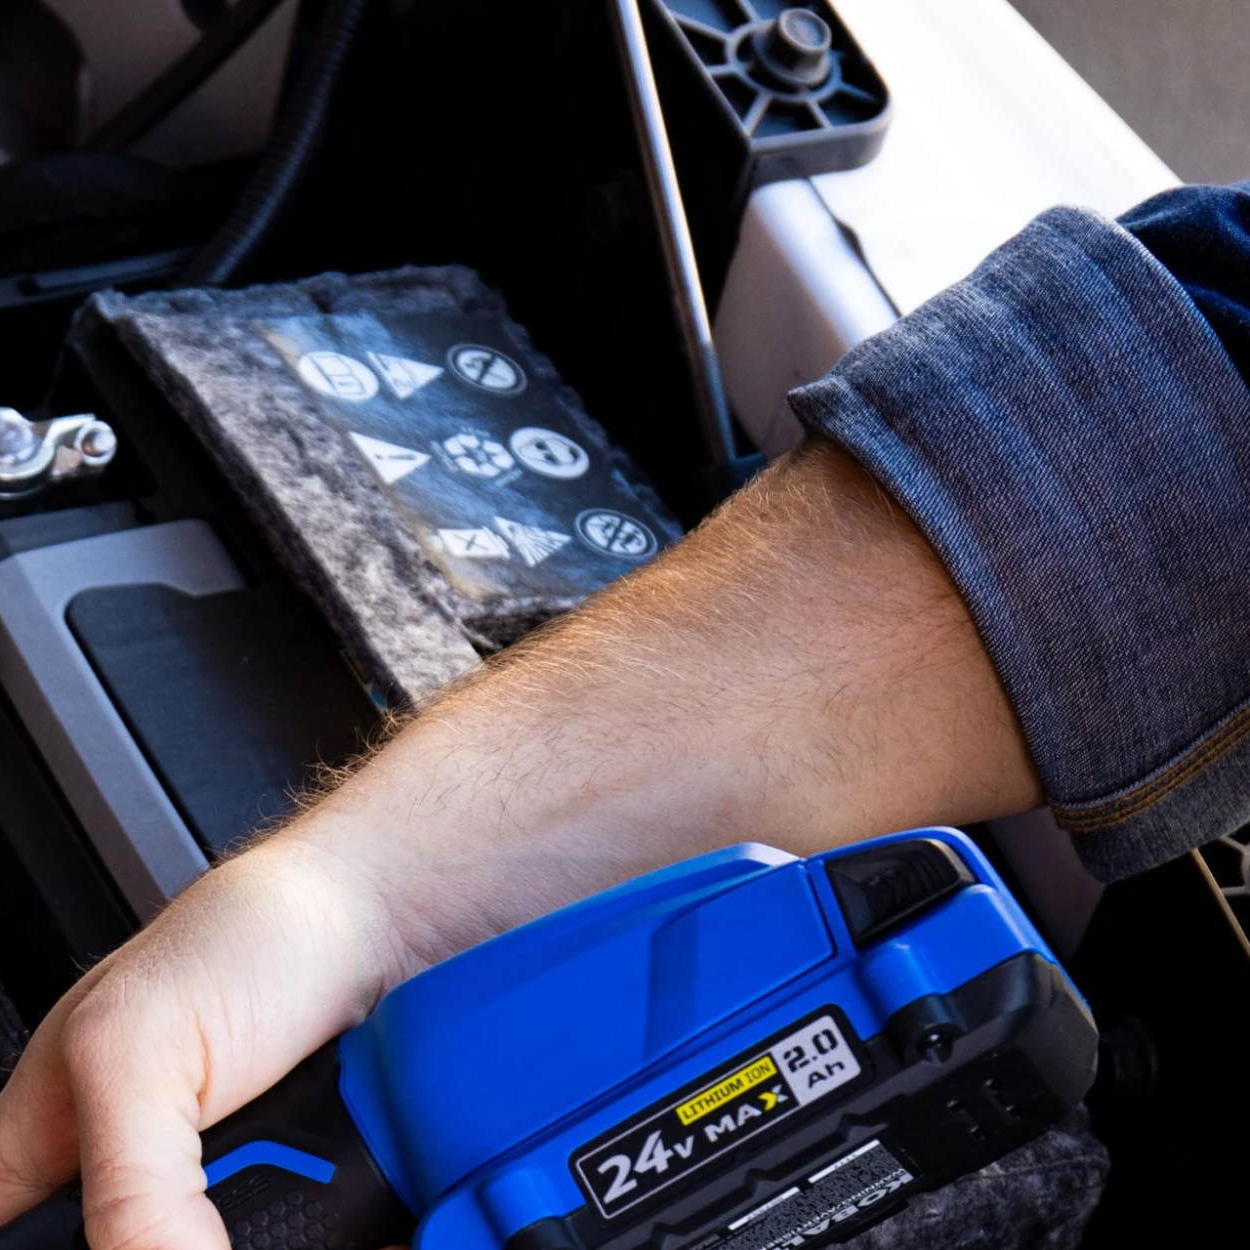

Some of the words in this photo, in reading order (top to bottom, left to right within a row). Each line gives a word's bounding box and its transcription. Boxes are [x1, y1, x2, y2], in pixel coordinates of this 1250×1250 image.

[784, 1028, 839, 1073] 2.0
[807, 1061, 846, 1089] Ah
[681, 1077, 744, 1120] LITHIUM
[746, 1062, 772, 1084] ION
[704, 1084, 789, 1143] MAX
